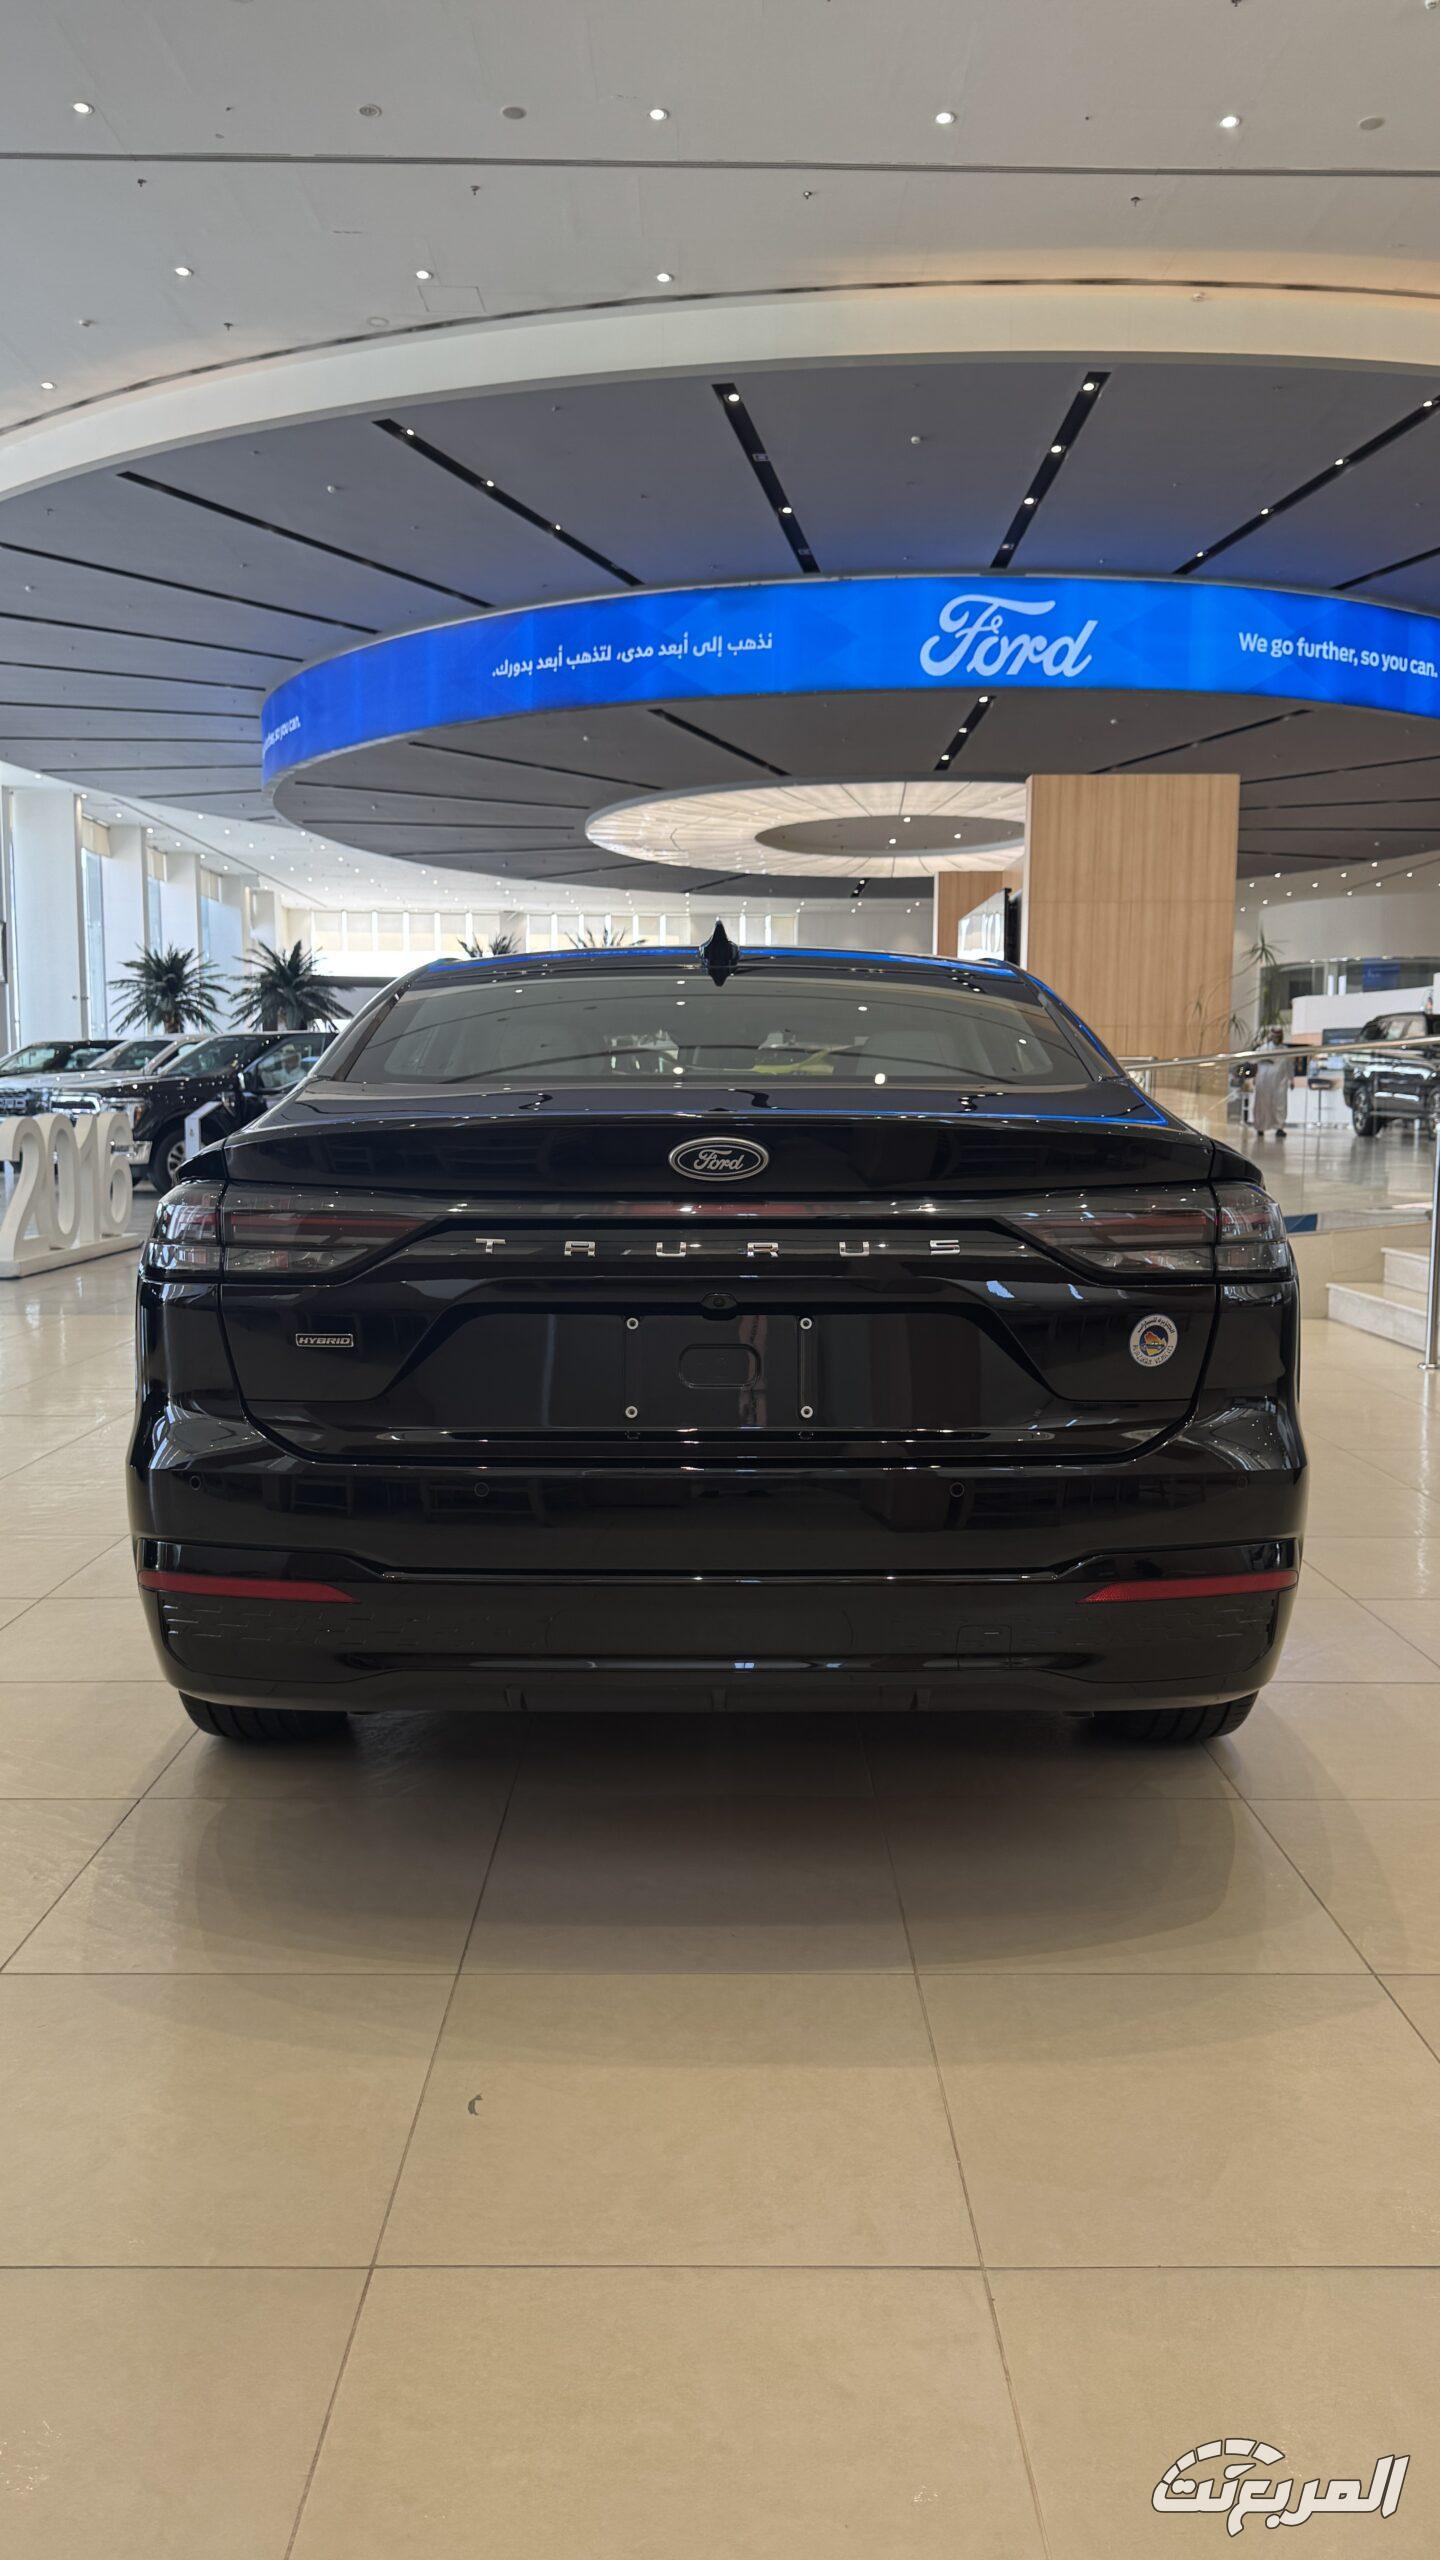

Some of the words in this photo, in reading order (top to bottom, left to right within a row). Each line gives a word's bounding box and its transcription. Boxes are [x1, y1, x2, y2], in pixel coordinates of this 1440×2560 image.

[657, 631, 689, 659] أبعد
[692, 634, 723, 658] إلى
[727, 632, 773, 656] نذهب
[919, 594, 1098, 677] Ford
[536, 644, 563, 672] أبعد
[566, 644, 612, 670] لتذهب
[1238, 631, 1268, 653] We
[1270, 637, 1294, 658] go
[1296, 636, 1358, 667] further,
[1360, 649, 1380, 667] so
[1381, 653, 1408, 672] you
[1409, 659, 1438, 678] can.
[693, 1148, 745, 1171] Ford
[0, 1112, 134, 1261] 2016
[475, 1237, 961, 1258] TAURUS
[298, 1336, 351, 1346] HYBRID
